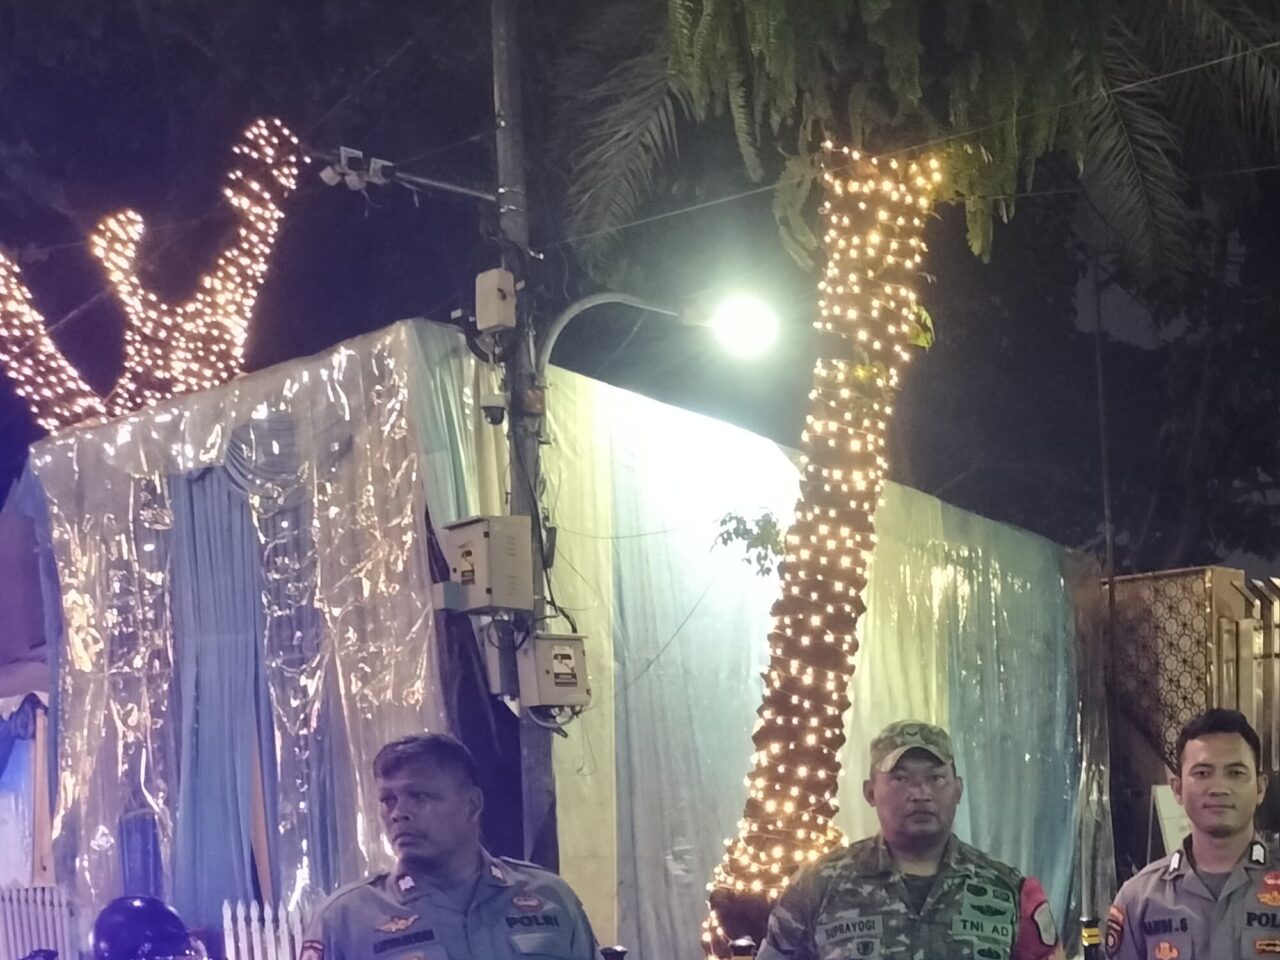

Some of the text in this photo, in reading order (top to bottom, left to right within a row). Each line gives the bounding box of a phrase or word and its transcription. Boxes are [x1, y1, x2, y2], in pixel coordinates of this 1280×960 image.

[505, 915, 560, 929] POLRI
[824, 918, 877, 939] SUPRAYOGI
[960, 918, 1009, 937] TNI AD
